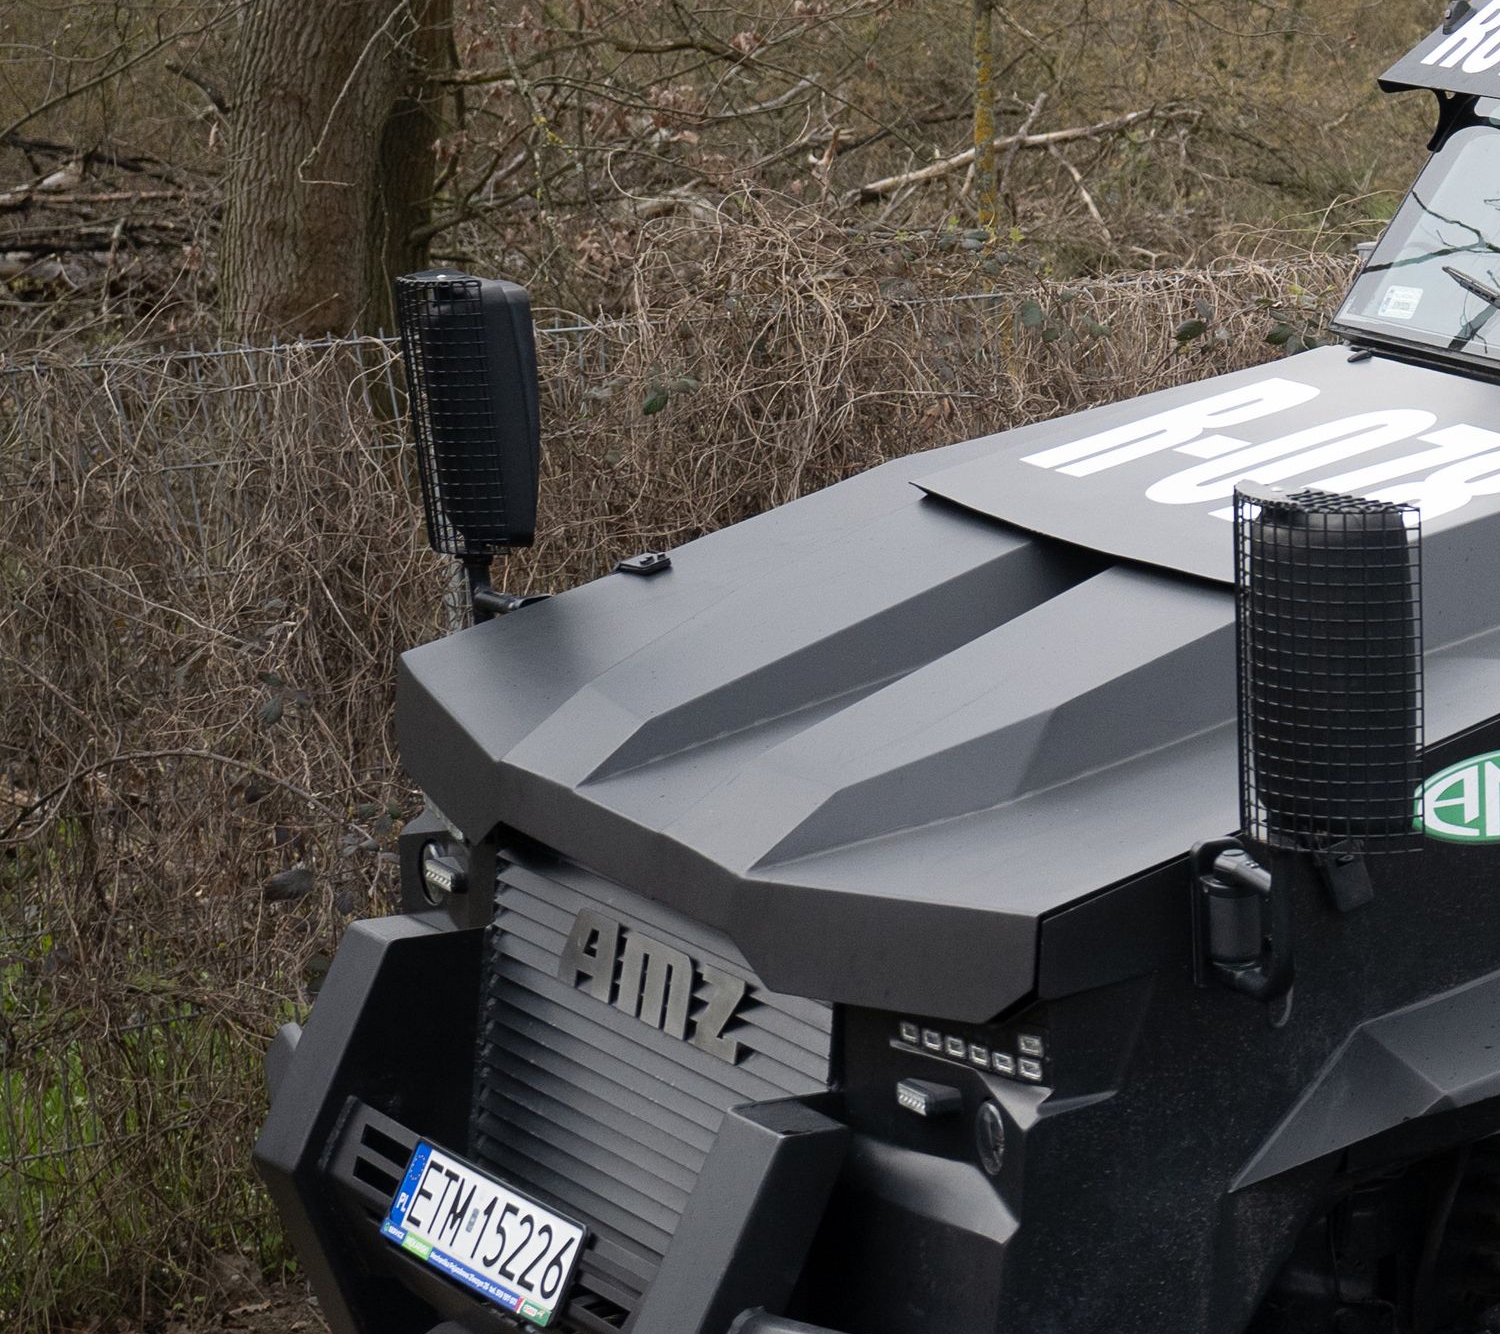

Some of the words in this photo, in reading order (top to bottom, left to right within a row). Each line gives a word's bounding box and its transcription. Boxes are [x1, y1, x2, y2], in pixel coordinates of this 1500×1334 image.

[557, 906, 747, 1066] AMZ
[396, 1191, 410, 1213] PL
[406, 1159, 478, 1248] ETM
[470, 1195, 576, 1301] 15226
